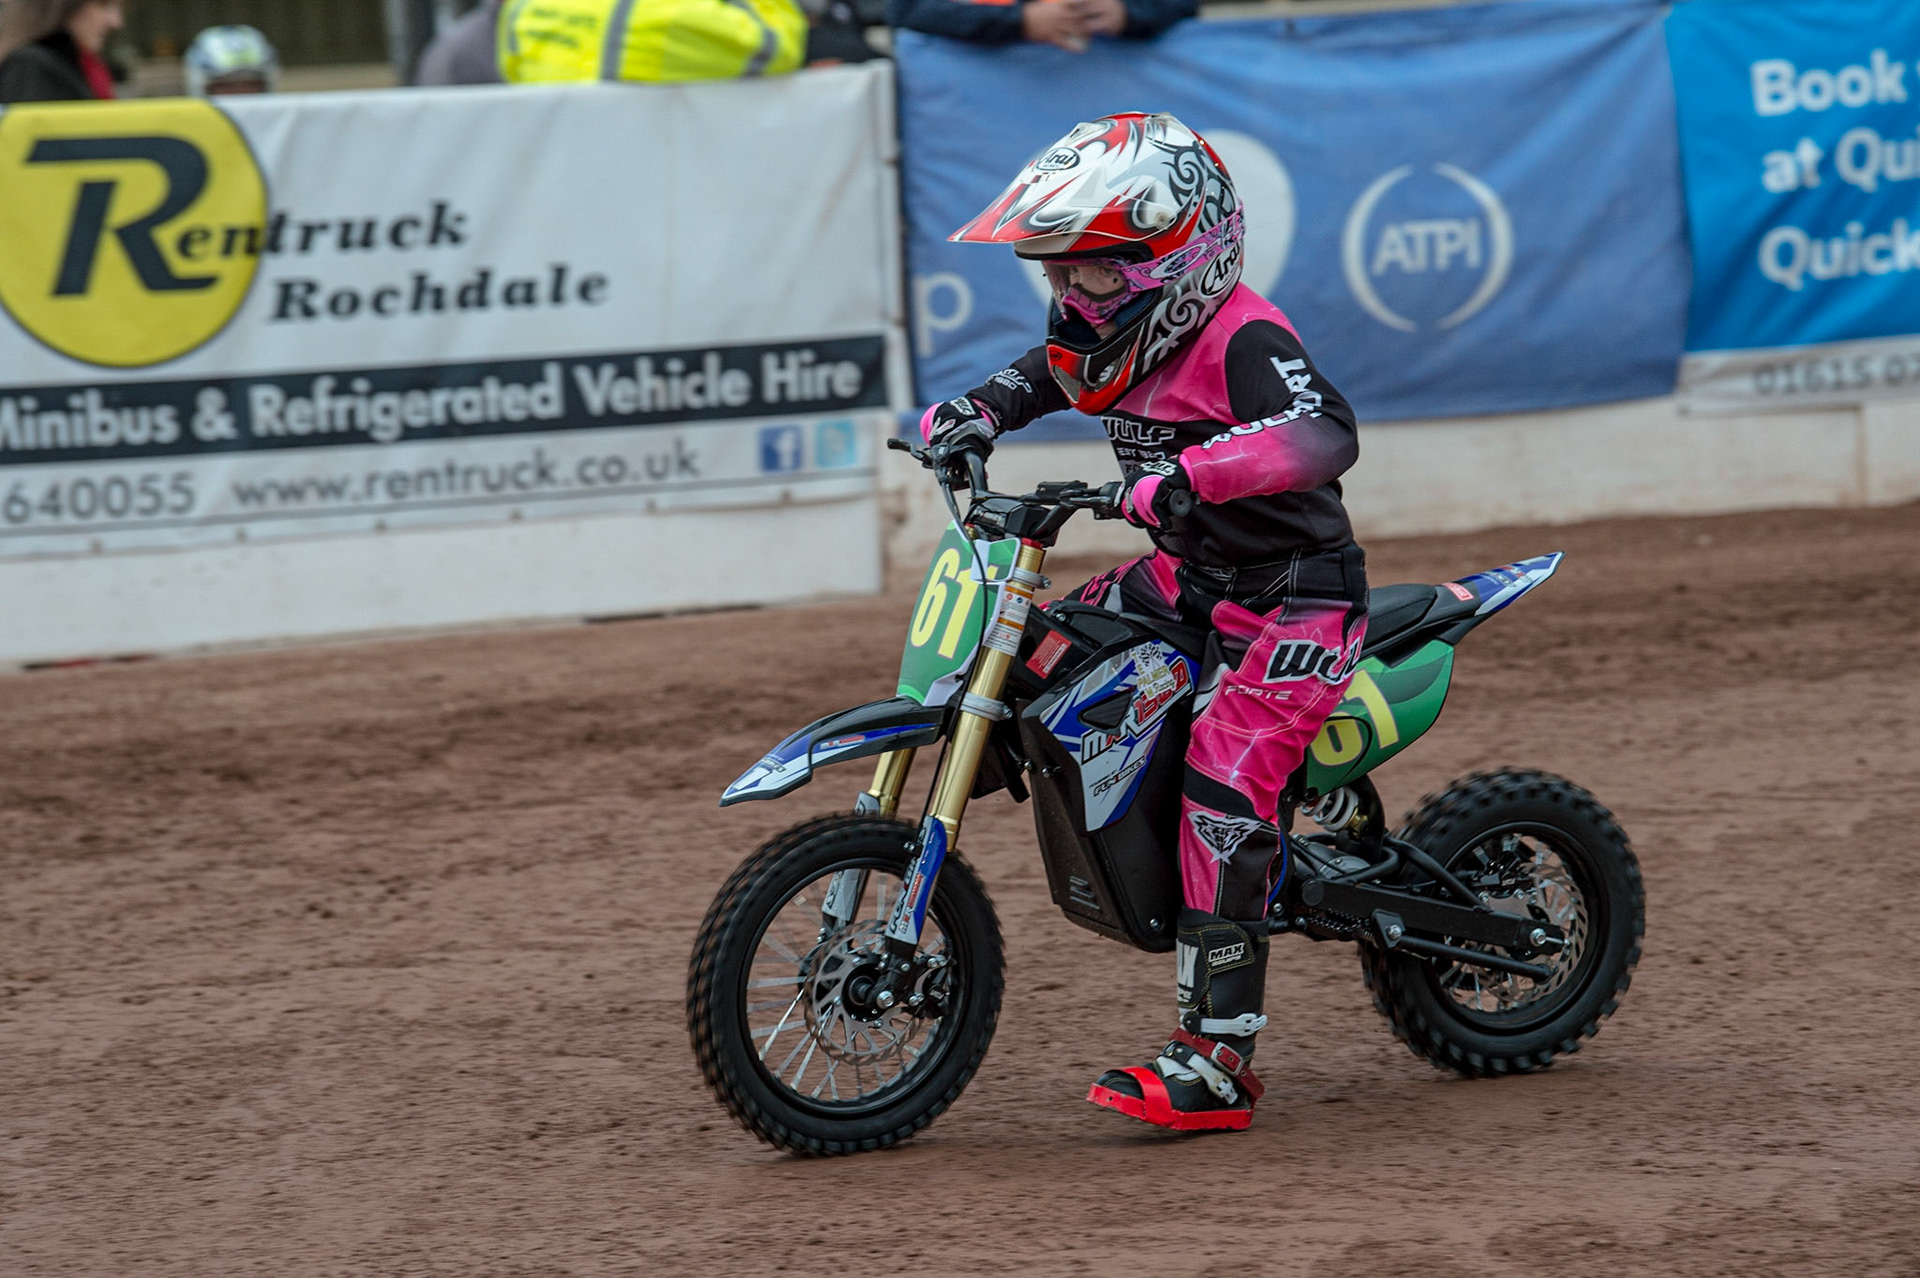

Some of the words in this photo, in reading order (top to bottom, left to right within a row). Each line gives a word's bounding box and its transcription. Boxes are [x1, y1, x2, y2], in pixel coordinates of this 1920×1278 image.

[1751, 49, 1907, 116] Book
[1761, 136, 1823, 193] at
[23, 134, 470, 298] Rentruck
[1372, 218, 1481, 276] ATPI
[270, 262, 610, 324] Rochdale
[192, 387, 239, 441] &
[248, 361, 567, 443] Refrigerated
[573, 350, 752, 417] Vehicle
[761, 349, 863, 401] Hire
[3, 472, 197, 525] 640055
[230, 437, 700, 507] www.rentruck.co.uk
[910, 548, 999, 660] 61
[1225, 685, 1293, 701] FORTE
[1310, 666, 1399, 767] 61
[1208, 943, 1245, 962] MAX
